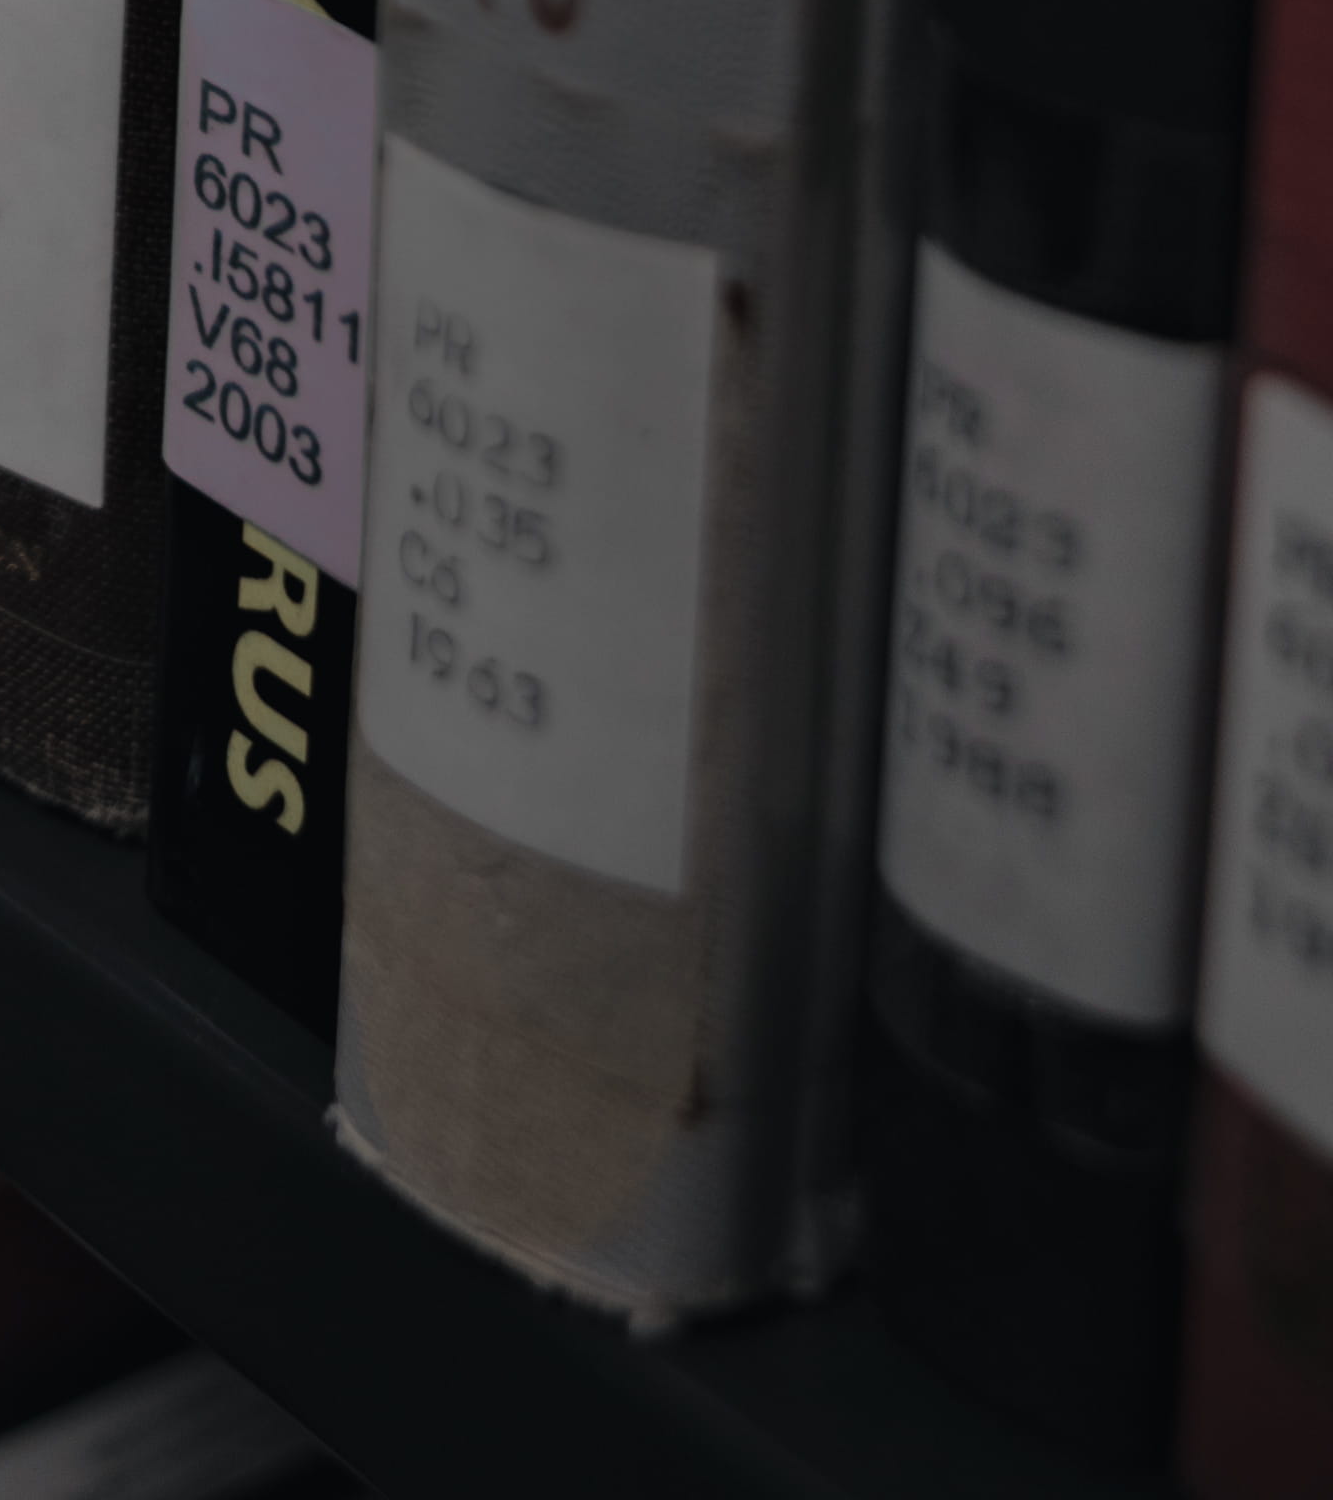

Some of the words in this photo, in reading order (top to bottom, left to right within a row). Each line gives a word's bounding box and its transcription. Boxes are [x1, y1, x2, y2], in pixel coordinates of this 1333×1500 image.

[197, 79, 284, 175] PR
[194, 154, 334, 271] 6023
[187, 283, 300, 399] V68
[412, 298, 482, 380] PR
[184, 360, 324, 488] 2003
[408, 386, 566, 492] 6023
[225, 520, 323, 837] RUS
[408, 614, 552, 731] 1963
